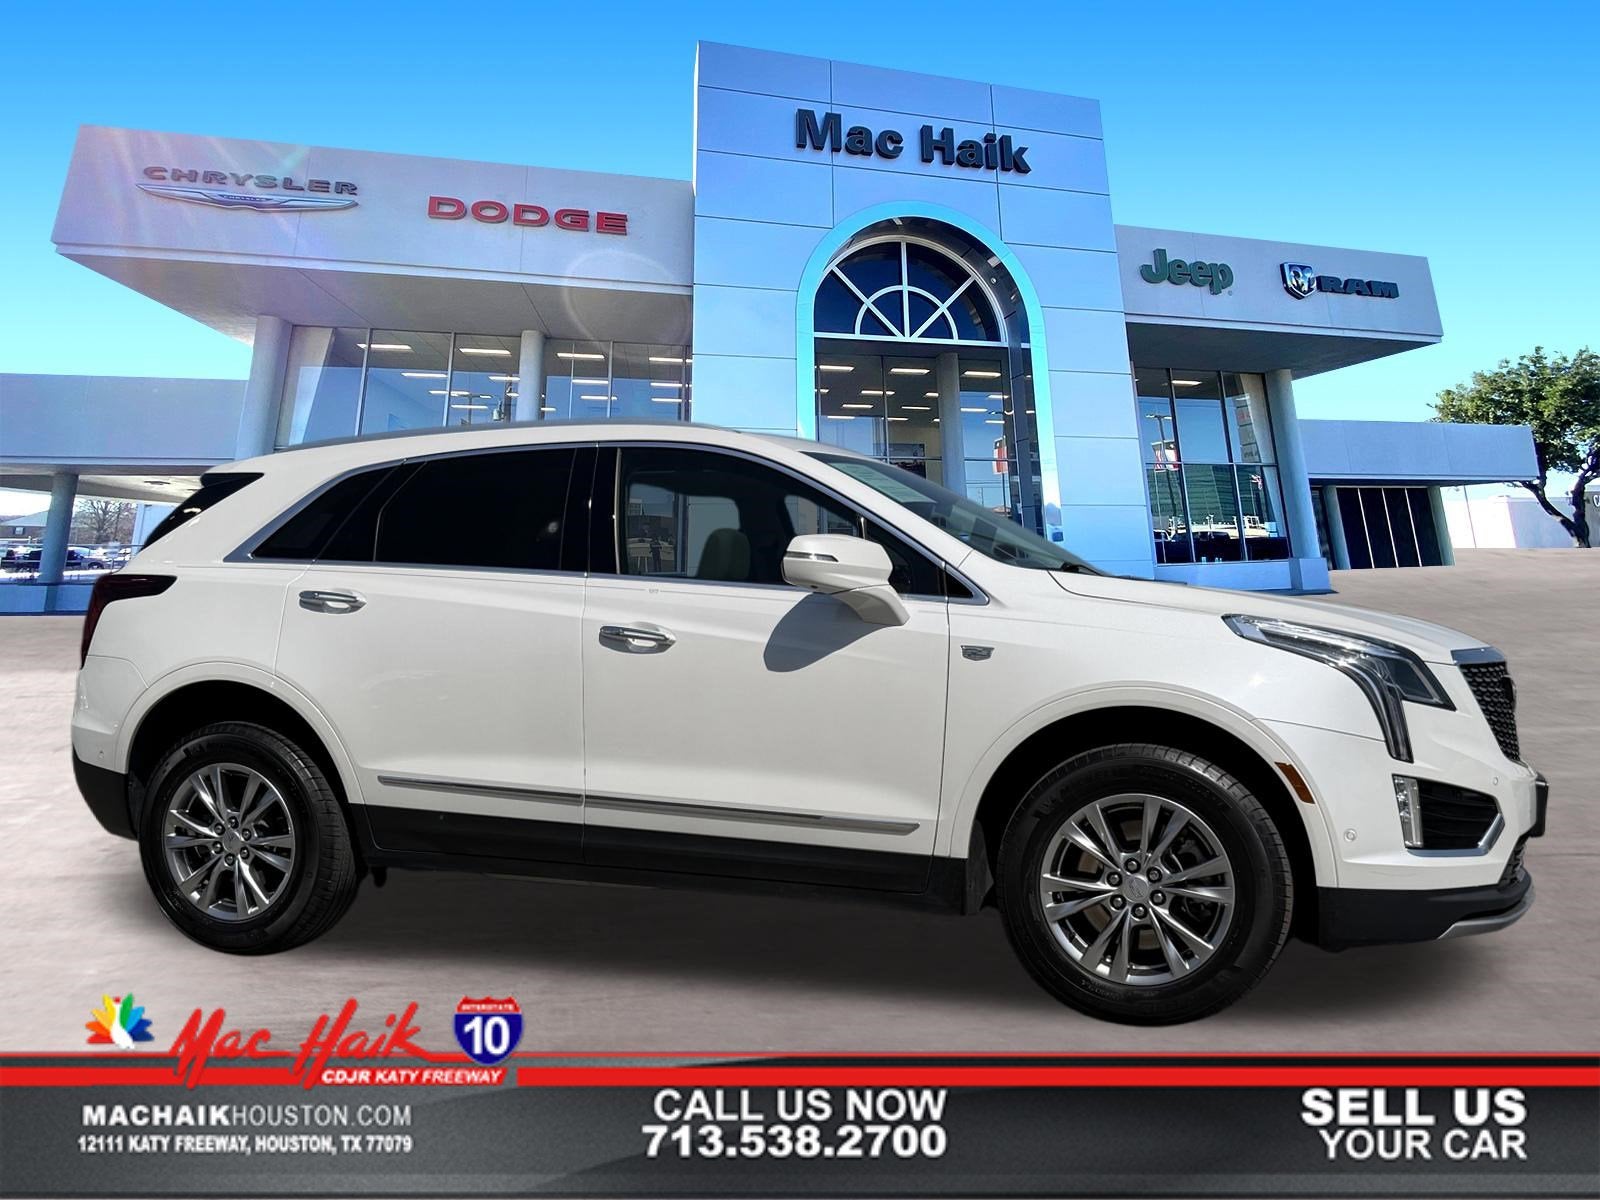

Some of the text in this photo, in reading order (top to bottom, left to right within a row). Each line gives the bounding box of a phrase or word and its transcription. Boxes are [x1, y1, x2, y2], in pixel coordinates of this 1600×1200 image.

[796, 108, 1032, 174] Mac Haik
[143, 166, 358, 196] CHRYSLER
[427, 195, 628, 236] DODGE
[1139, 248, 1234, 295] Jeep
[1316, 275, 1400, 299] RAM
